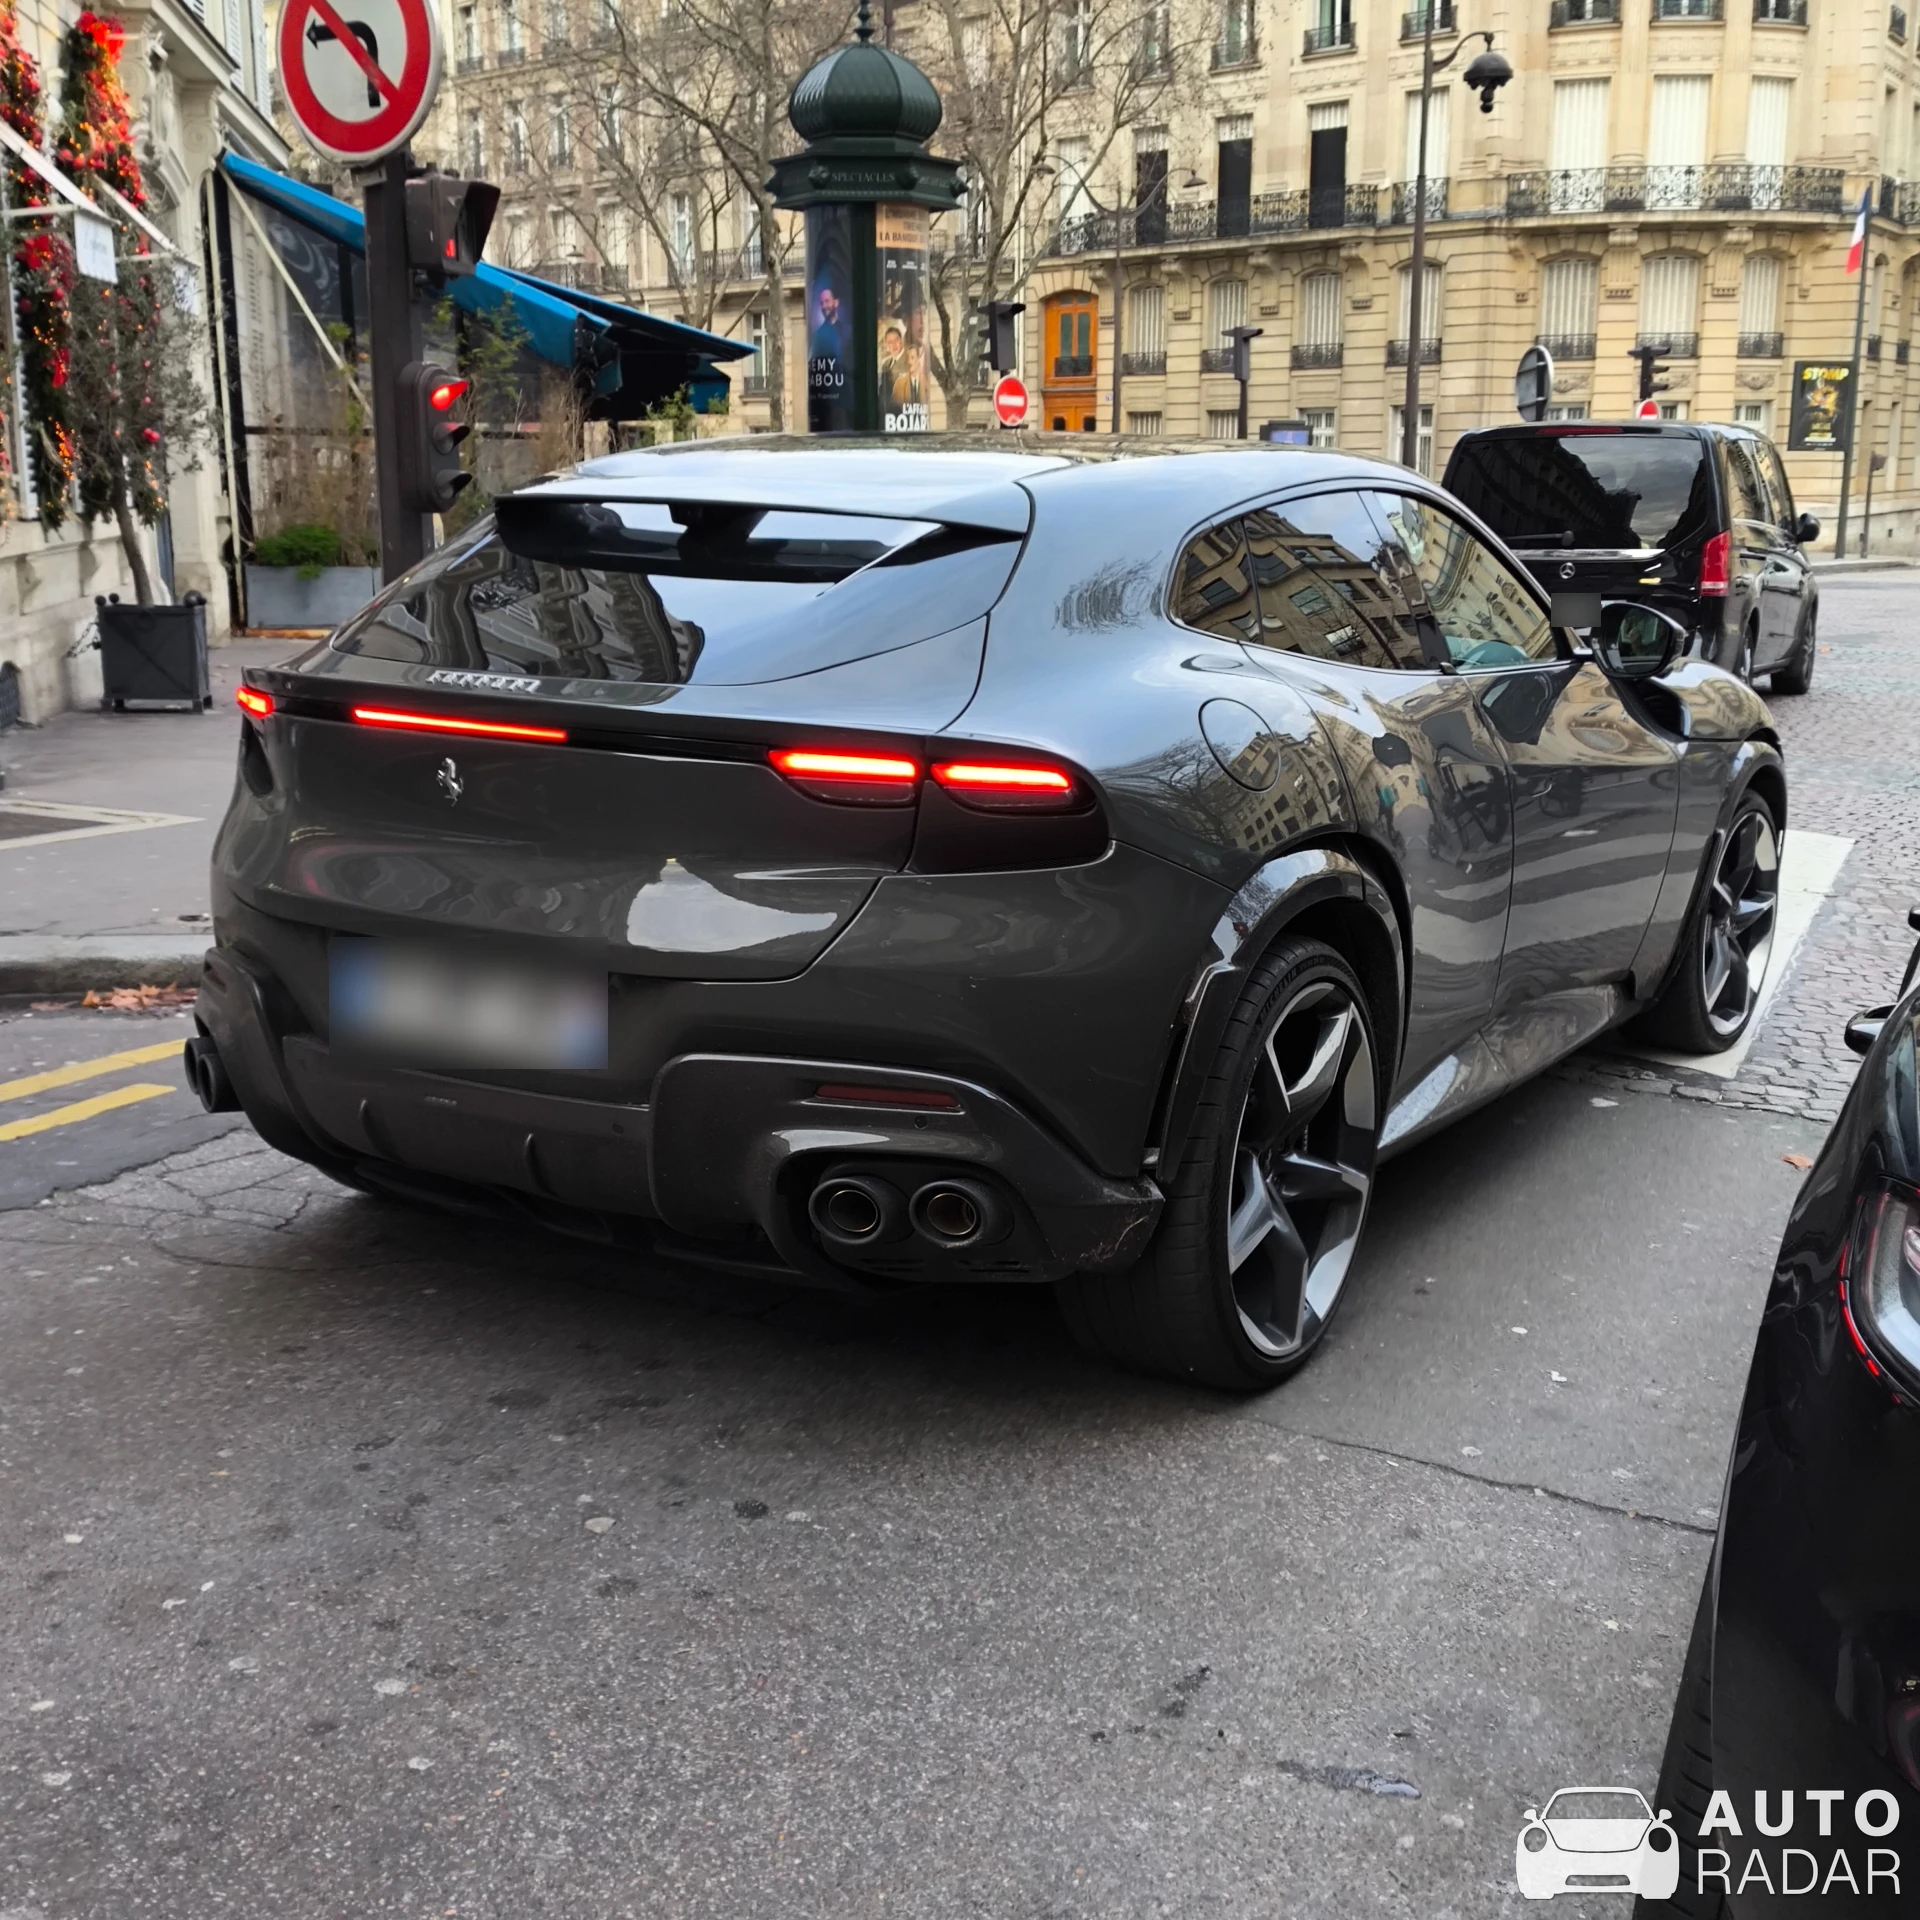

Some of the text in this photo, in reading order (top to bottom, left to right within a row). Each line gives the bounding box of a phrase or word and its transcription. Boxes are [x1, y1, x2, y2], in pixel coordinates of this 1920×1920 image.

[831, 172, 895, 183] SPECTACLES
[880, 231, 890, 241] LA
[808, 372, 844, 387] ABOU
[1802, 367, 1850, 380] STOMP
